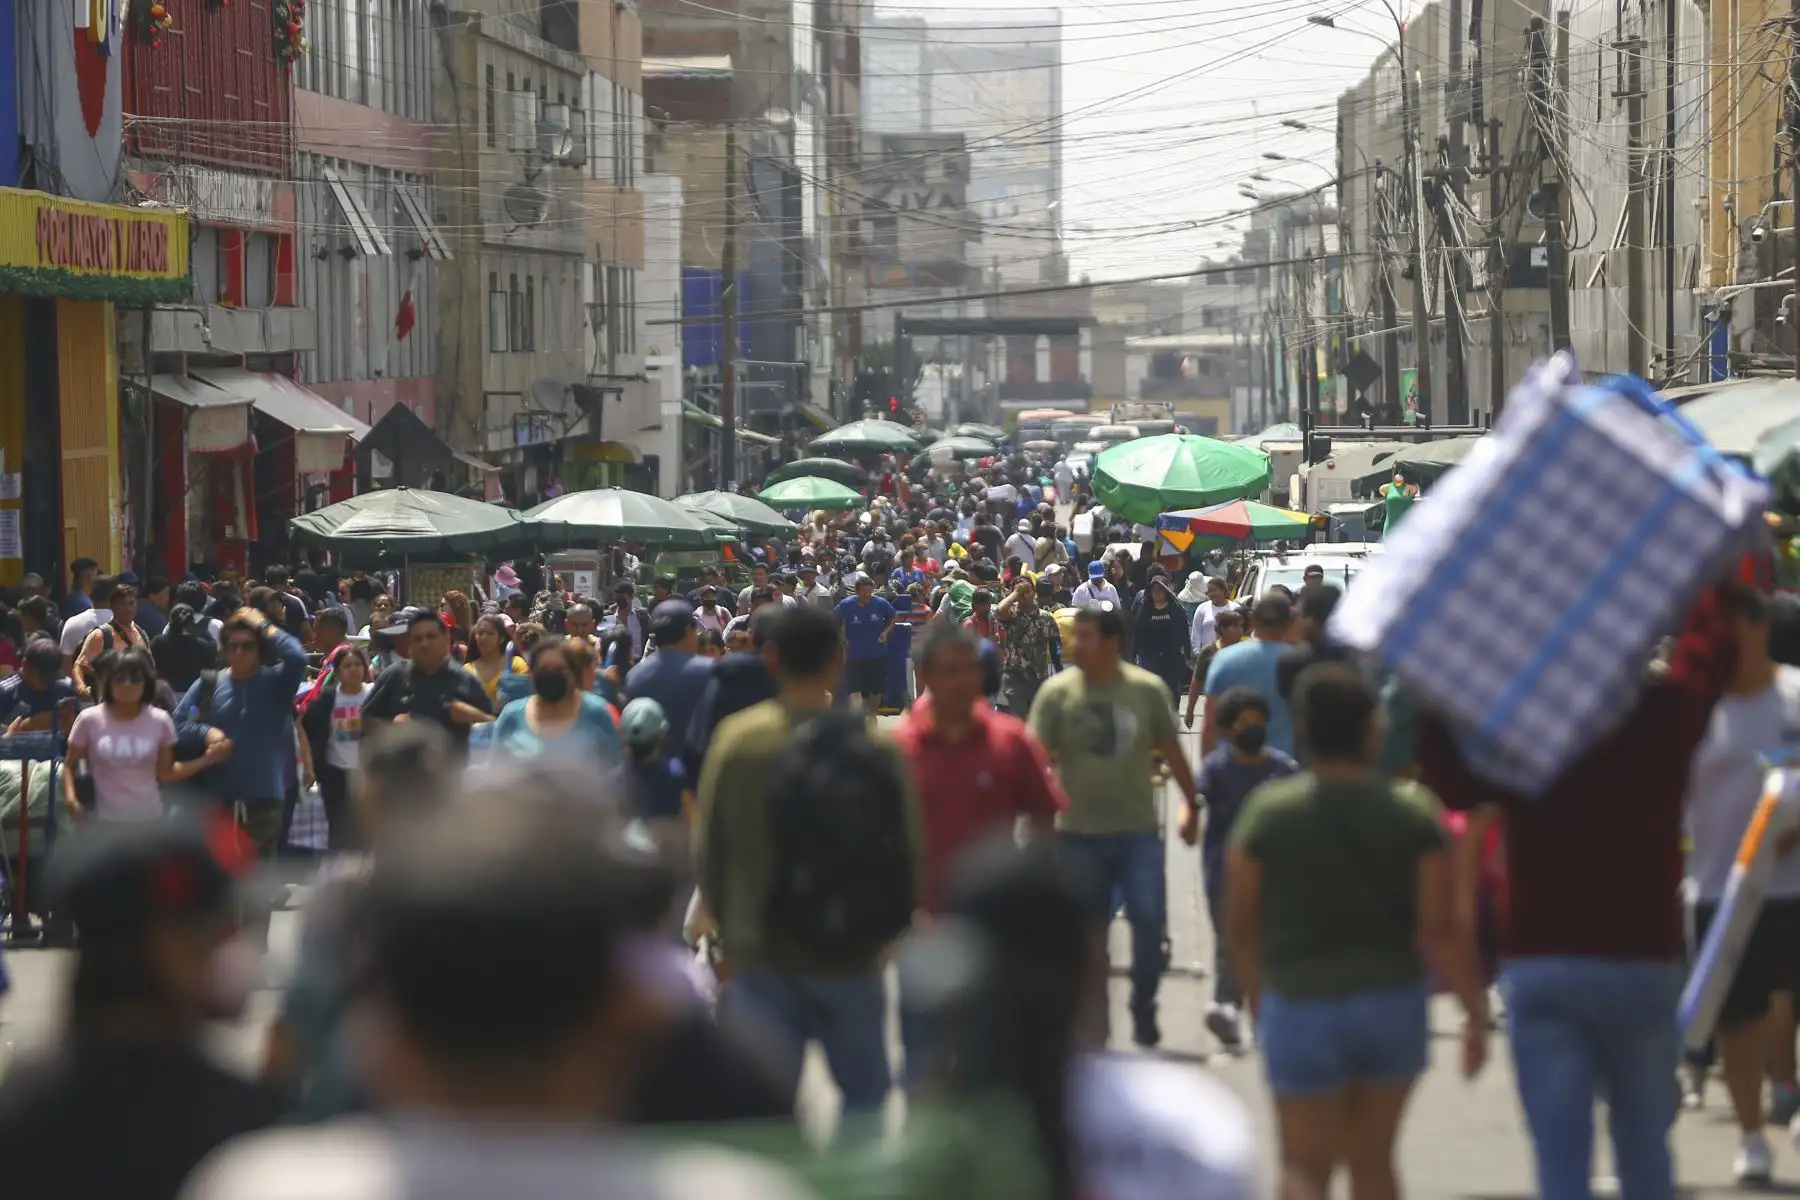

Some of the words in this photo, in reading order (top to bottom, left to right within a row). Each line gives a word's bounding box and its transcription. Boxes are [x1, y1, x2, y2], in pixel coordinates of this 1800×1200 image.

[37, 207, 69, 264] POR
[71, 213, 113, 270] MAYOR
[116, 219, 124, 270] Y
[127, 221, 168, 271] MENOR
